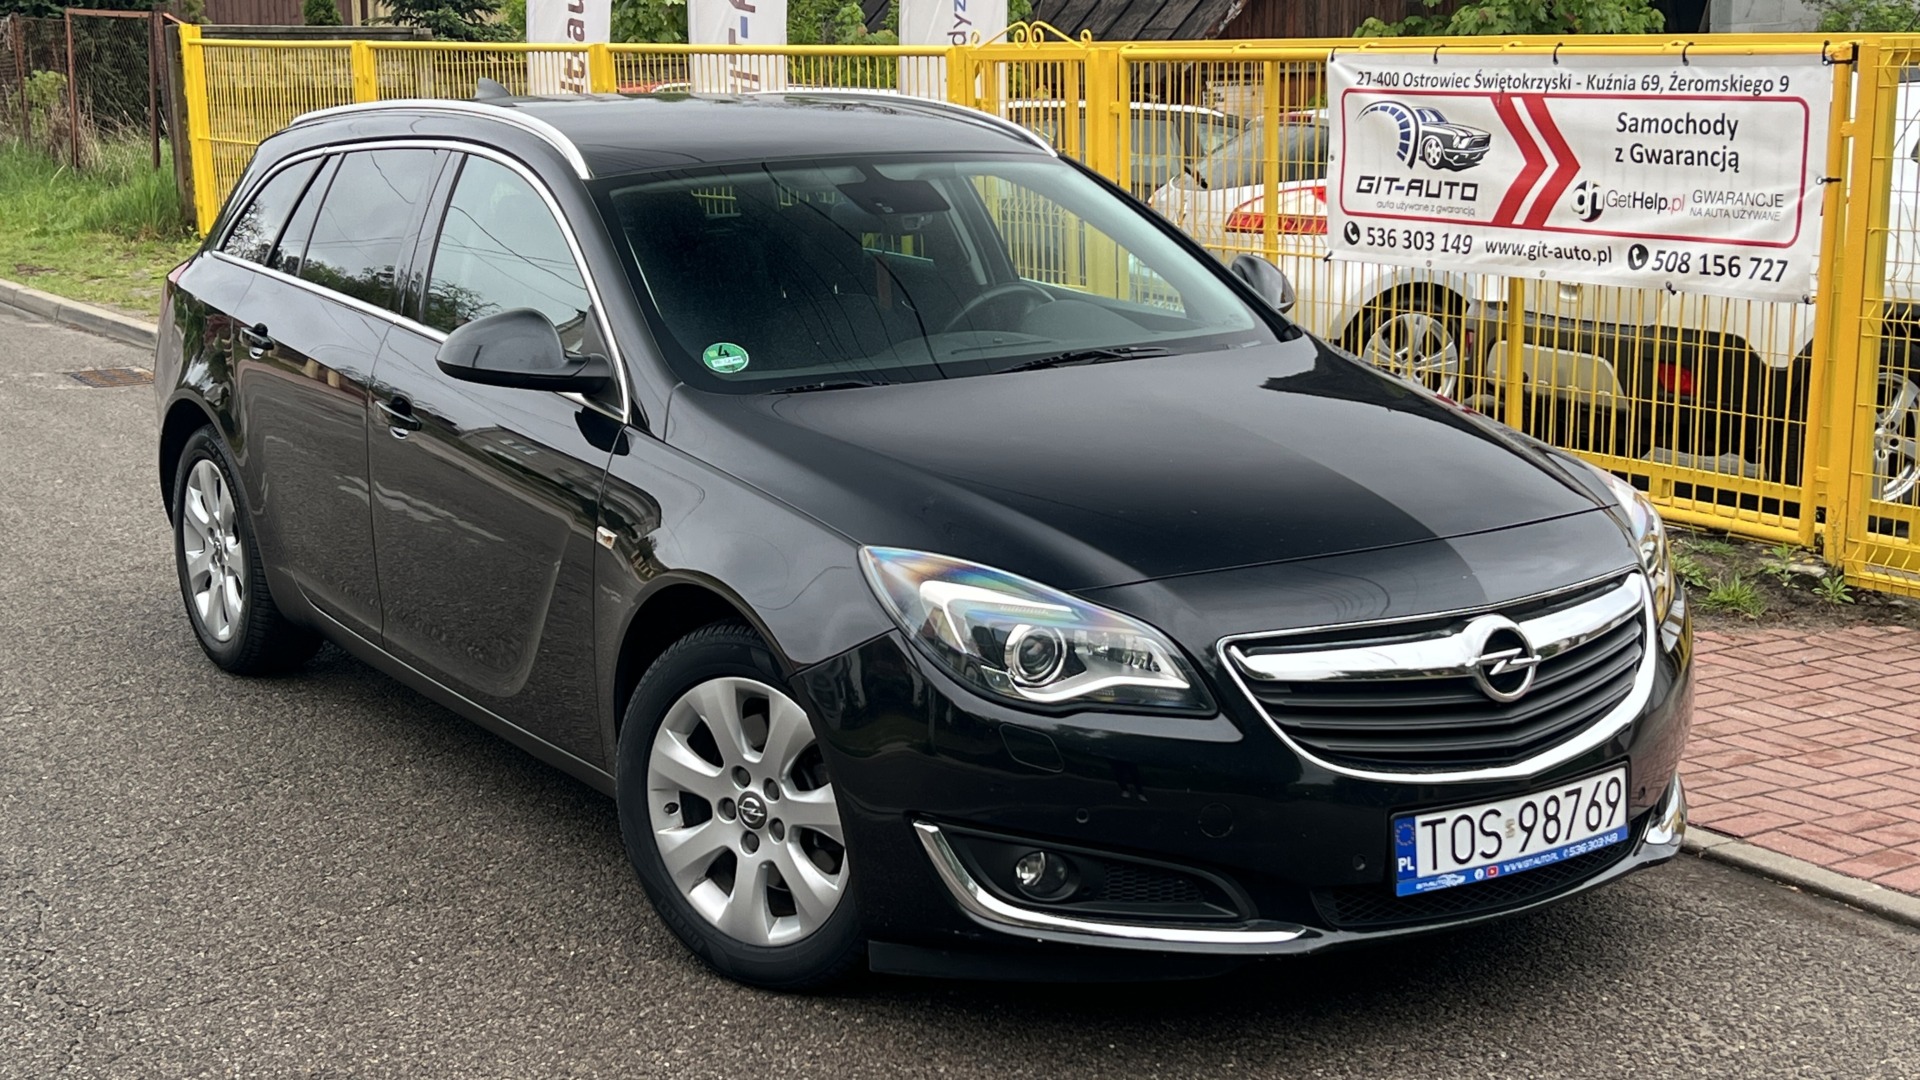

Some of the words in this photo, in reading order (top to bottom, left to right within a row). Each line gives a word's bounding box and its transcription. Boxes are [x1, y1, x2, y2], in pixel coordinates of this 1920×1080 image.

[1356, 71, 1399, 87] 27-400
[1402, 71, 1471, 89] Ostrowiec
[1473, 69, 1572, 95] Świętokrzyski
[1586, 73, 1637, 92] Kuźnia
[1641, 74, 1664, 95] 69,
[1668, 71, 1774, 96] Żeromskiego
[1779, 75, 1790, 92] 9
[1616, 112, 1739, 140] Samochody
[1615, 146, 1624, 163] z
[1629, 143, 1740, 173] Gwarancją
[1356, 175, 1478, 201] GIT-AUTO
[1692, 189, 1784, 208] GWARANCJE
[1376, 200, 1394, 209] auta
[1396, 201, 1429, 212] używane
[1430, 204, 1435, 212] z
[1436, 204, 1476, 217] gwarancją
[1605, 189, 1686, 215] GetHelp.pl
[1689, 207, 1702, 216] NA
[1704, 207, 1730, 219] AUTA
[1732, 207, 1781, 221] UŻYWANE
[1366, 226, 1397, 248] 536
[1402, 231, 1435, 251] 303
[1440, 233, 1473, 255] 149
[1485, 240, 1612, 264] www.git-auto.pl
[1651, 249, 1692, 274] 508
[1698, 253, 1742, 278] 156
[1748, 256, 1788, 282] 727
[717, 345, 730, 357] 4
[1421, 808, 1503, 871] TOS
[1518, 776, 1622, 853] 98769
[1397, 856, 1416, 873] PL
